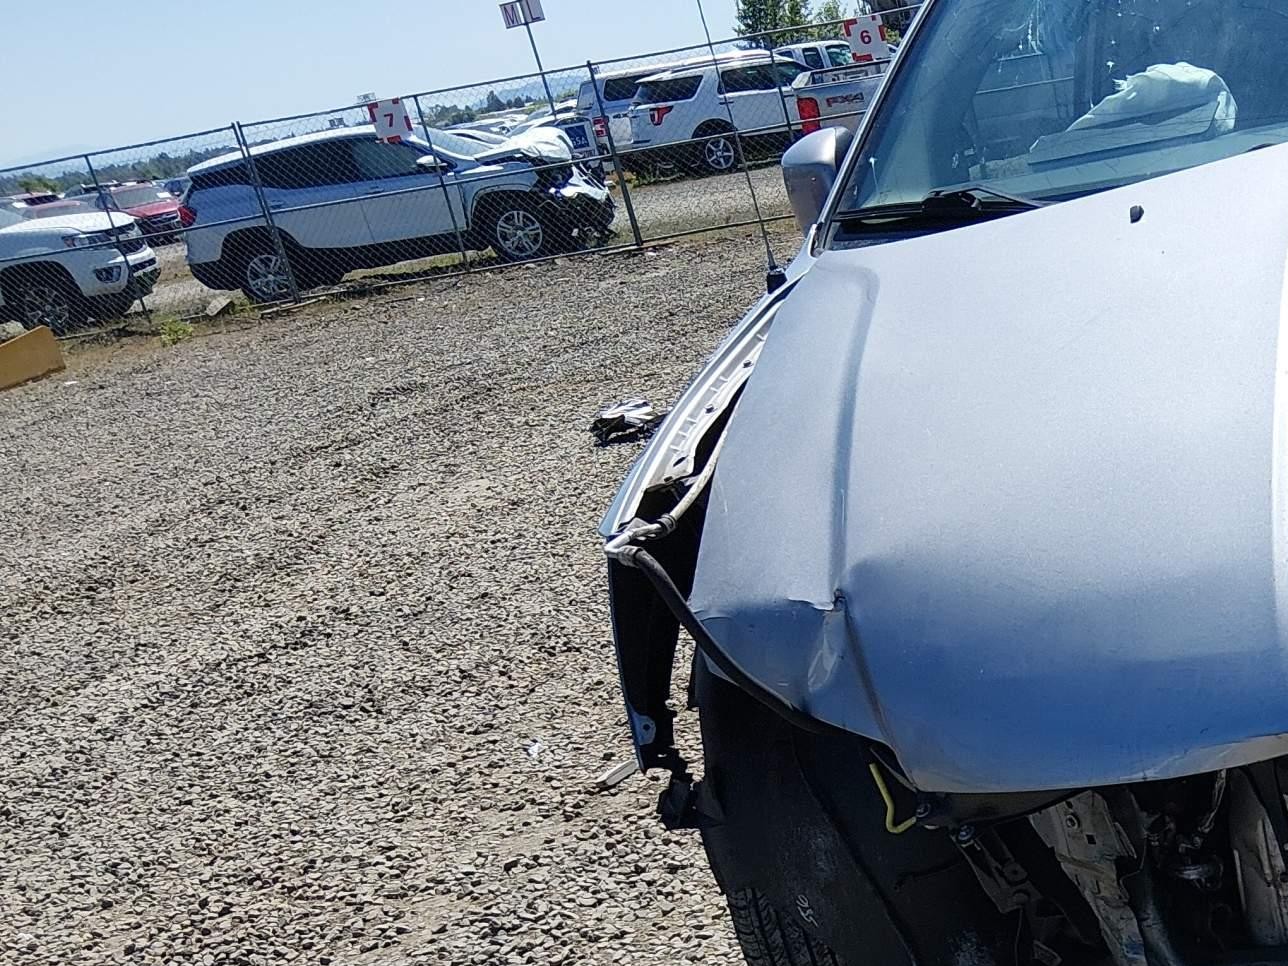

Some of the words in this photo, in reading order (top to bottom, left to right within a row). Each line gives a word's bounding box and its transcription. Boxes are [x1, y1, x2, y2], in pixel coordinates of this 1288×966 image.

[503, 5, 519, 25] M
[860, 30, 872, 44] 6
[383, 113, 394, 128] 7
